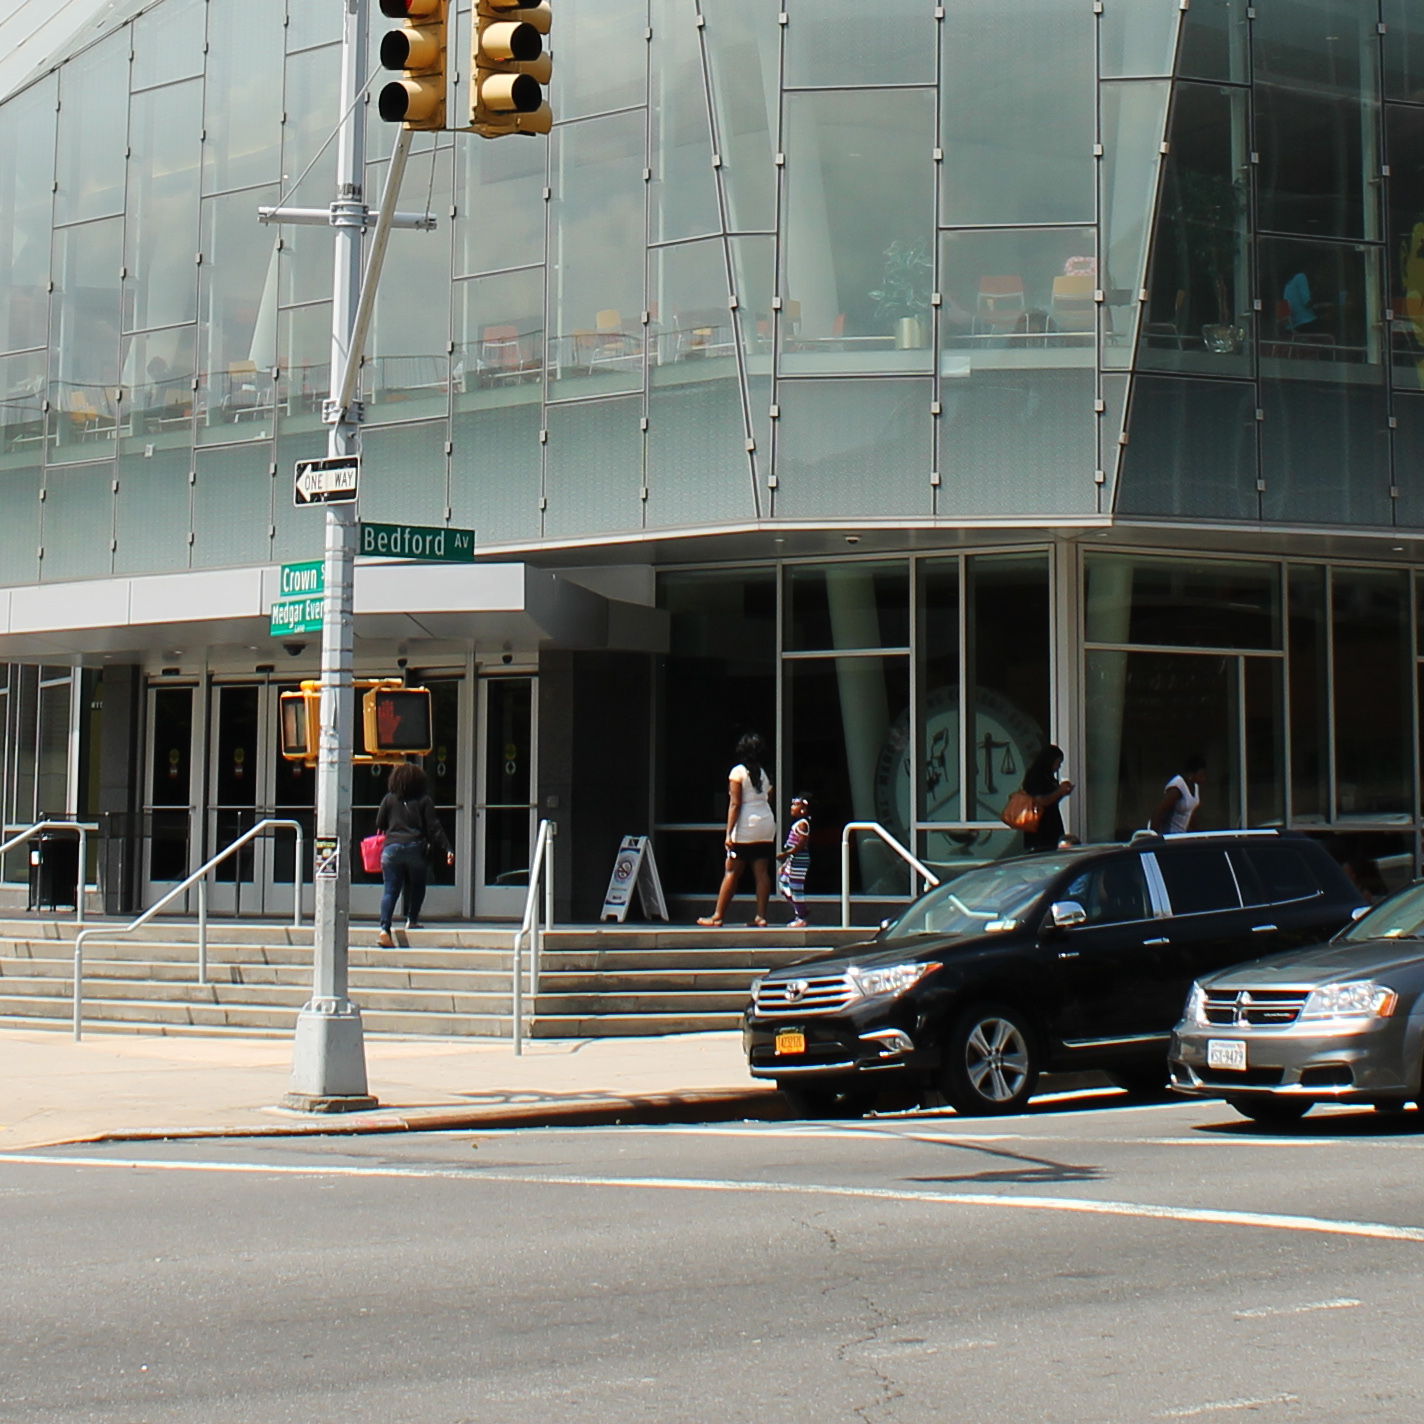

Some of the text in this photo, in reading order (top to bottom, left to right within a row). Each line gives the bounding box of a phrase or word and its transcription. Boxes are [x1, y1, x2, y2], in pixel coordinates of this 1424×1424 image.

[304, 471, 354, 490] ONE WAY
[364, 527, 469, 556] Bedford Av
[283, 567, 317, 592] Crown
[272, 599, 325, 629] Medgar Ever
